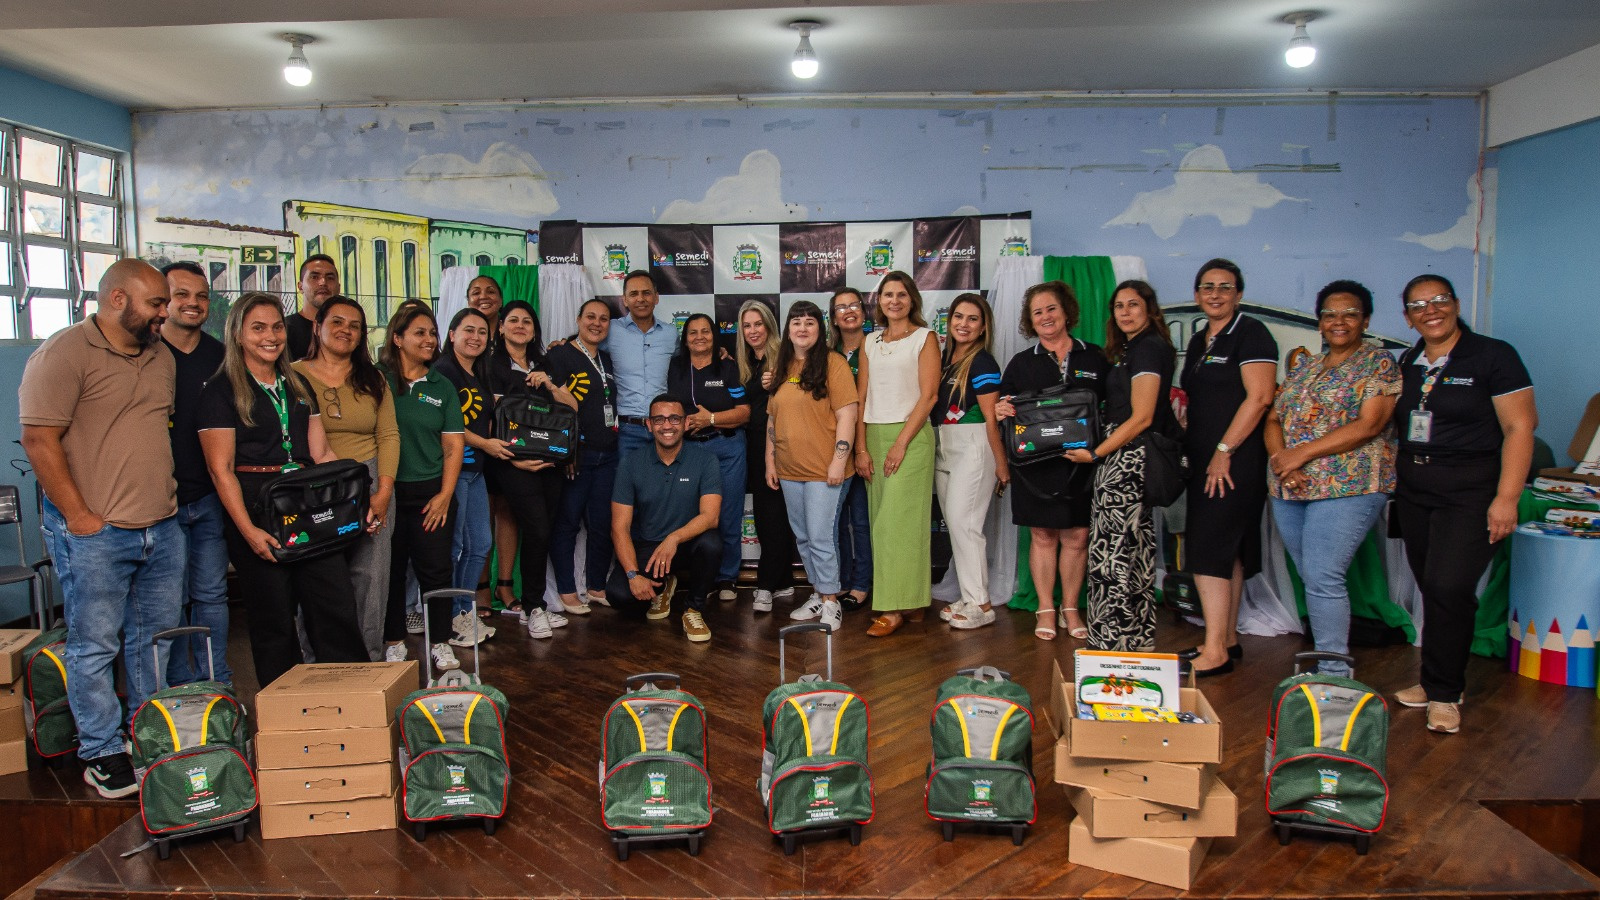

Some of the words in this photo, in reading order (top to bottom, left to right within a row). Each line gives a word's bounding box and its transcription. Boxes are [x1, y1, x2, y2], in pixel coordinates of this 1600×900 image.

[675, 250, 709, 261] semedi
[807, 248, 842, 259] semedi
[941, 245, 976, 256] semedi
[545, 252, 579, 263] semedi
